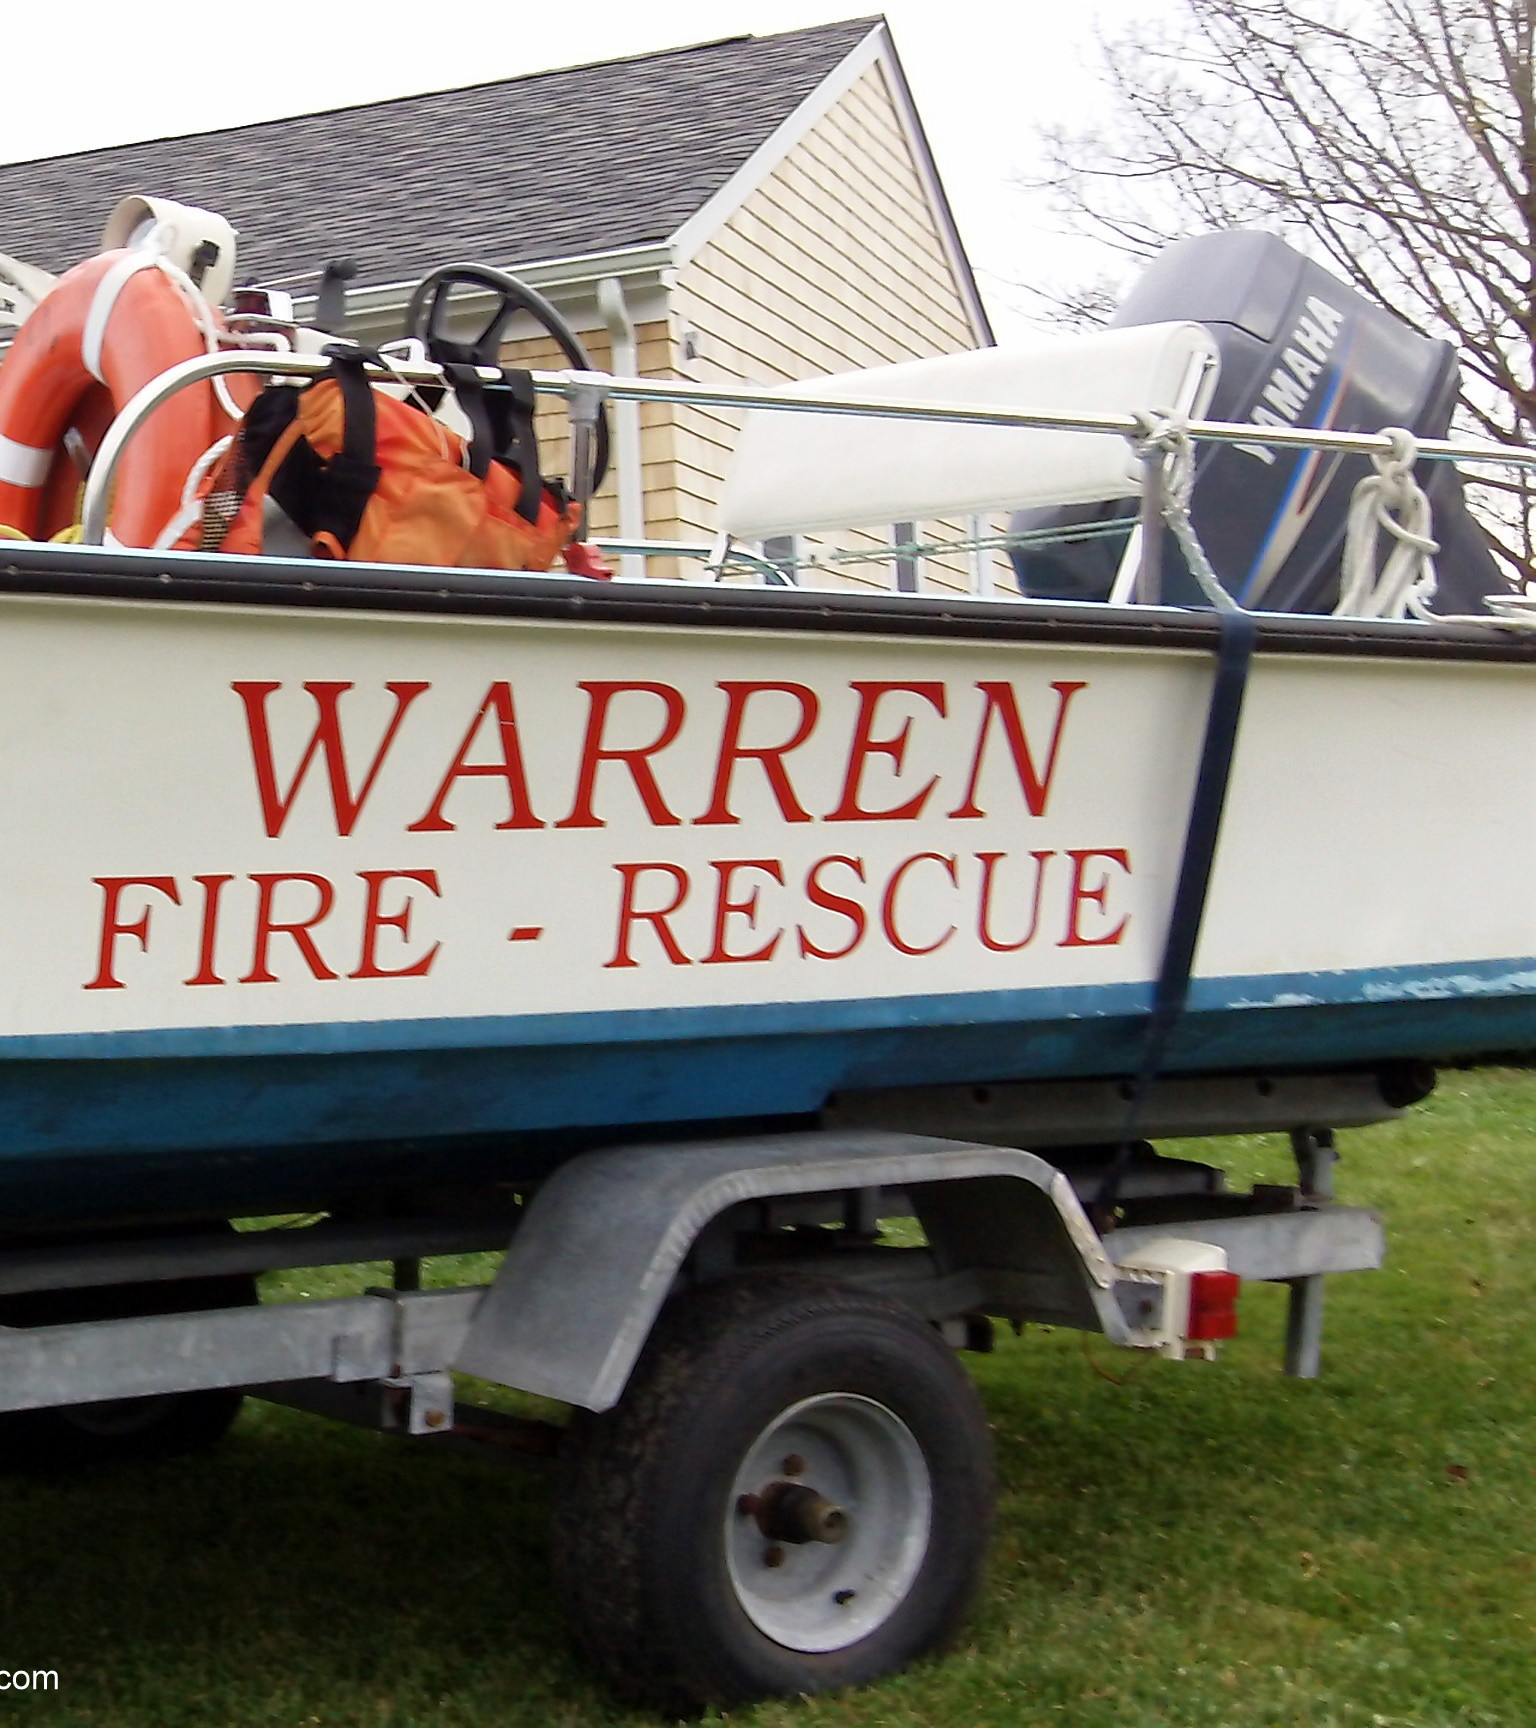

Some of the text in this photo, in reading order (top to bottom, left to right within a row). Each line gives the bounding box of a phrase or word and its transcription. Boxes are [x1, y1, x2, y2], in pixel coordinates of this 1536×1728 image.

[230, 680, 1087, 838] WARREN
[83, 847, 1132, 990] FIRE - RESCUE
